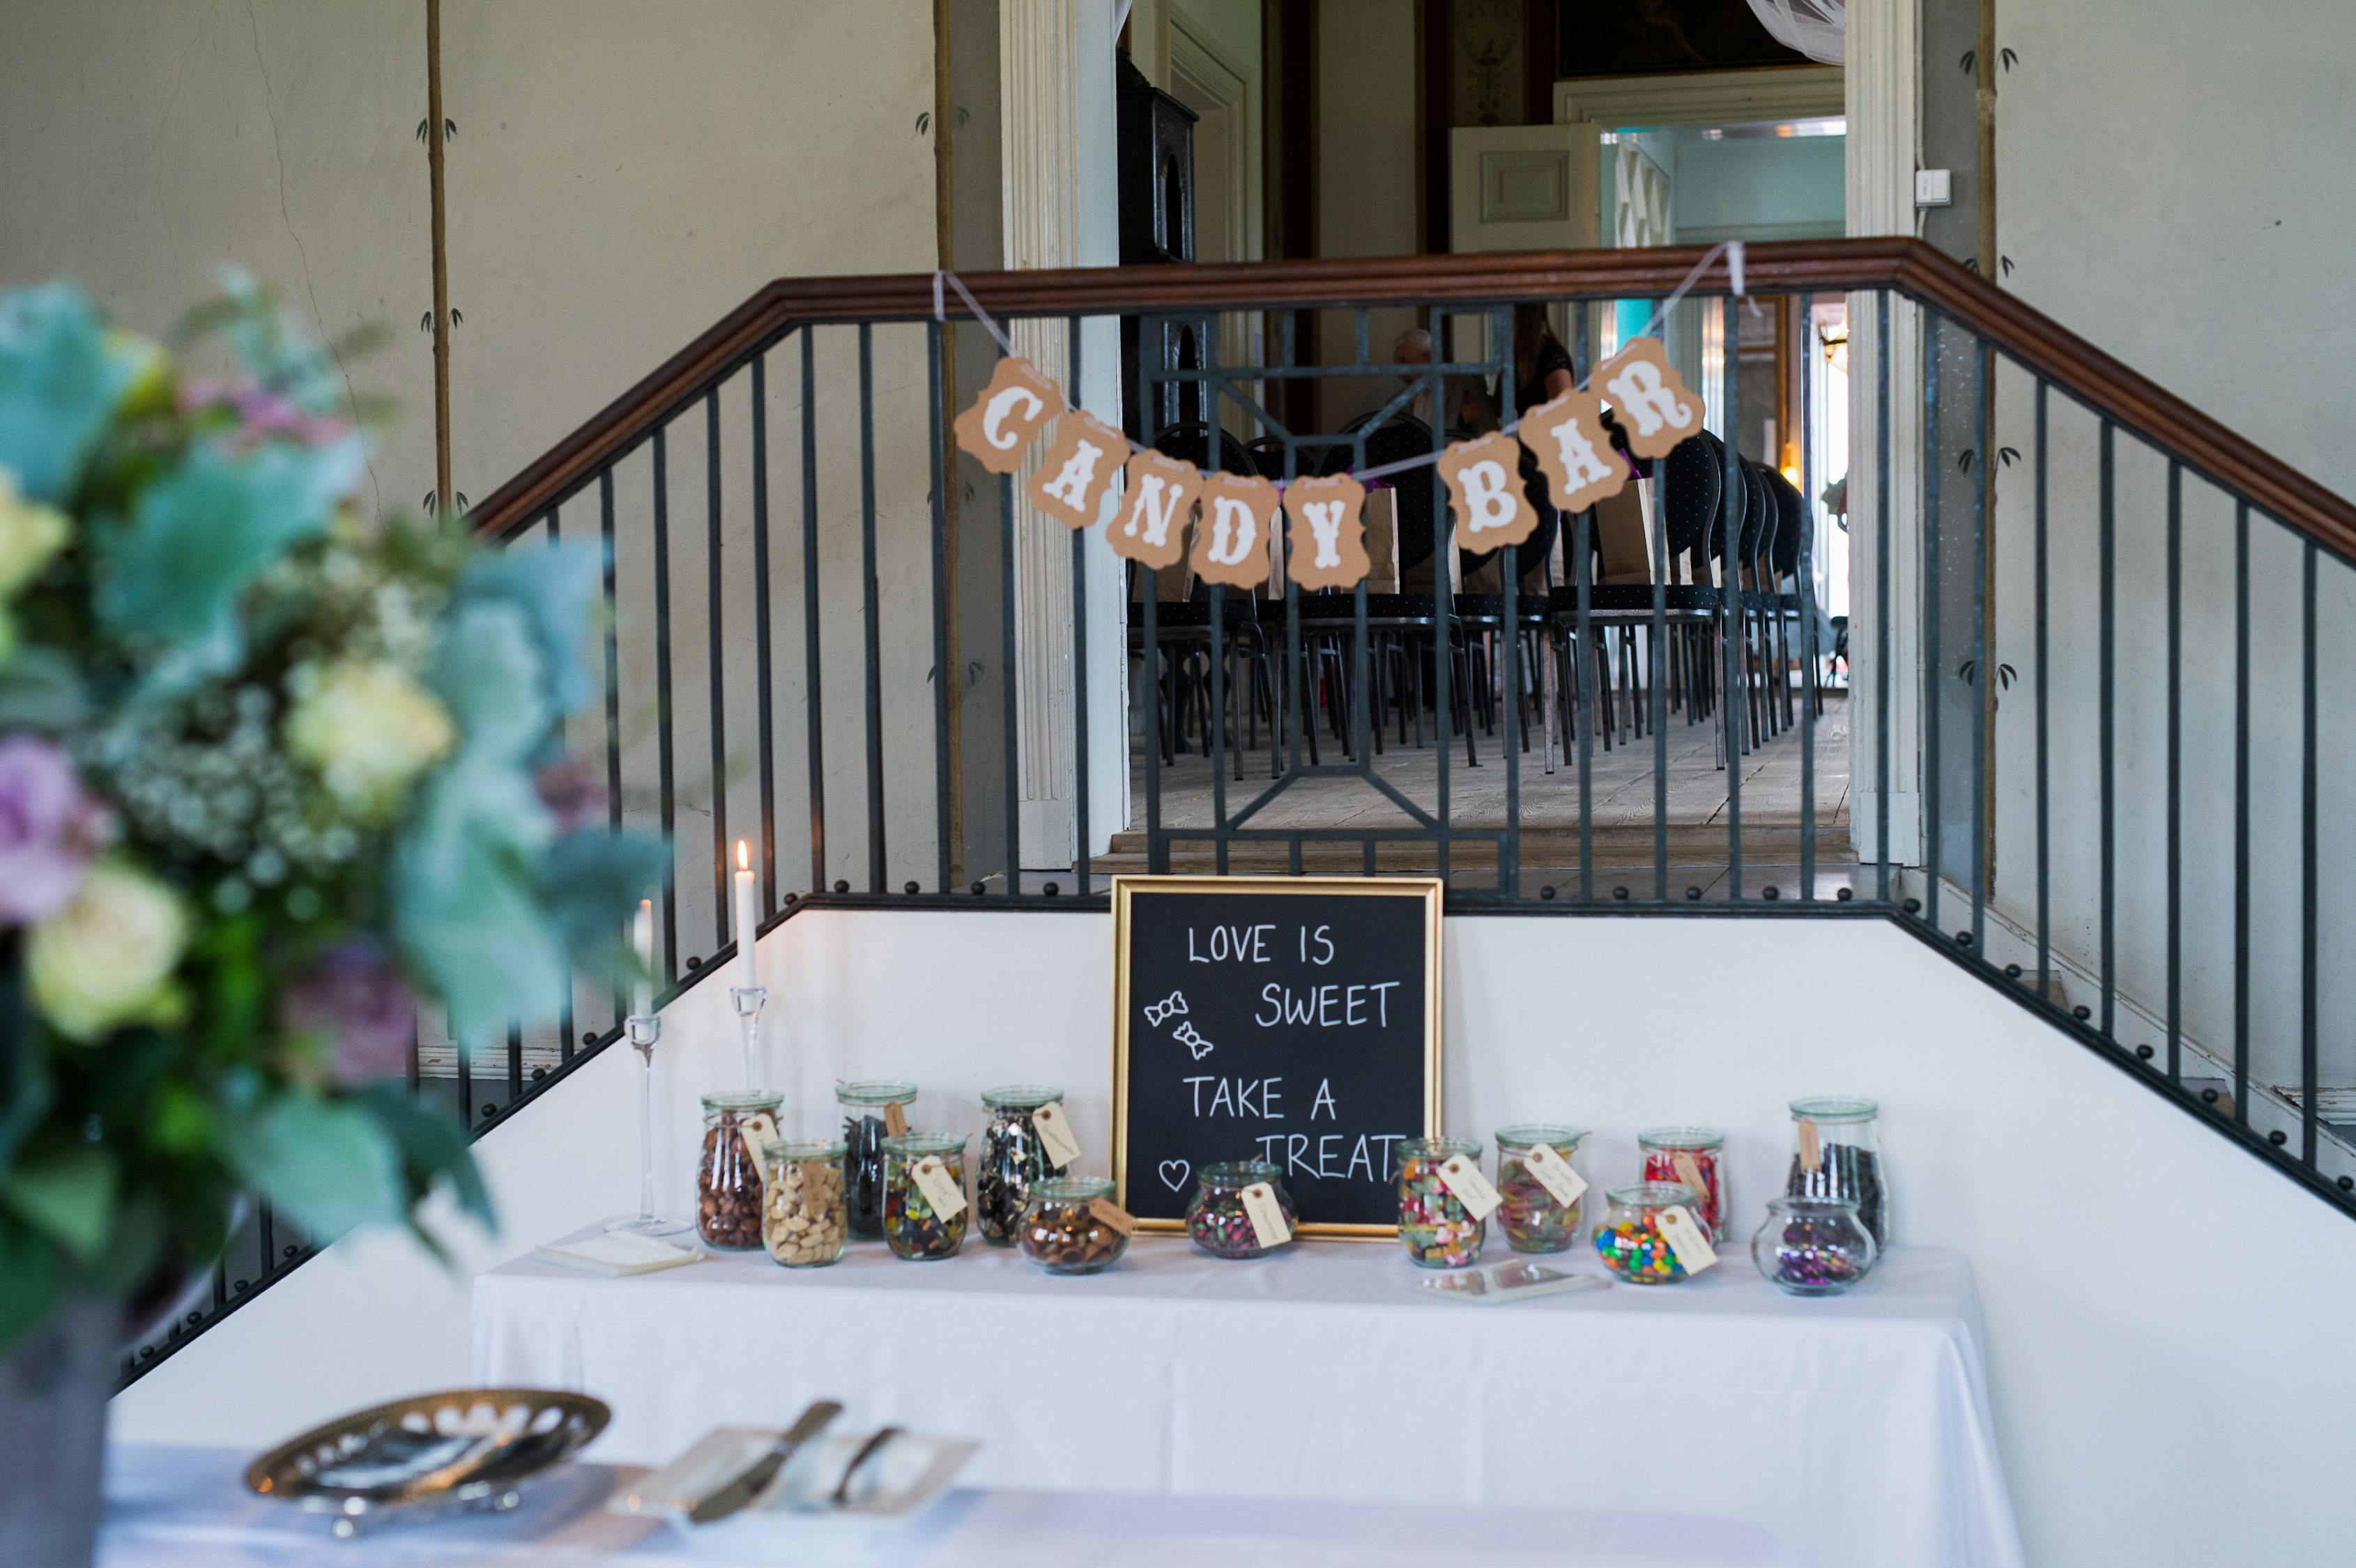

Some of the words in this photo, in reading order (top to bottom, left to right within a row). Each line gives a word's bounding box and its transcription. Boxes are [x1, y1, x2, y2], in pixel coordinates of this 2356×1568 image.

[982, 385, 1347, 570] CANDY
[1456, 360, 1693, 534] BAR
[1188, 923, 1277, 964] LOVE
[1299, 924, 1335, 966] IS
[1255, 981, 1401, 1028] SWEET
[1182, 1075, 1285, 1119] TAKE
[1310, 1077, 1337, 1121] A
[1255, 1132, 1407, 1183] TREAT
